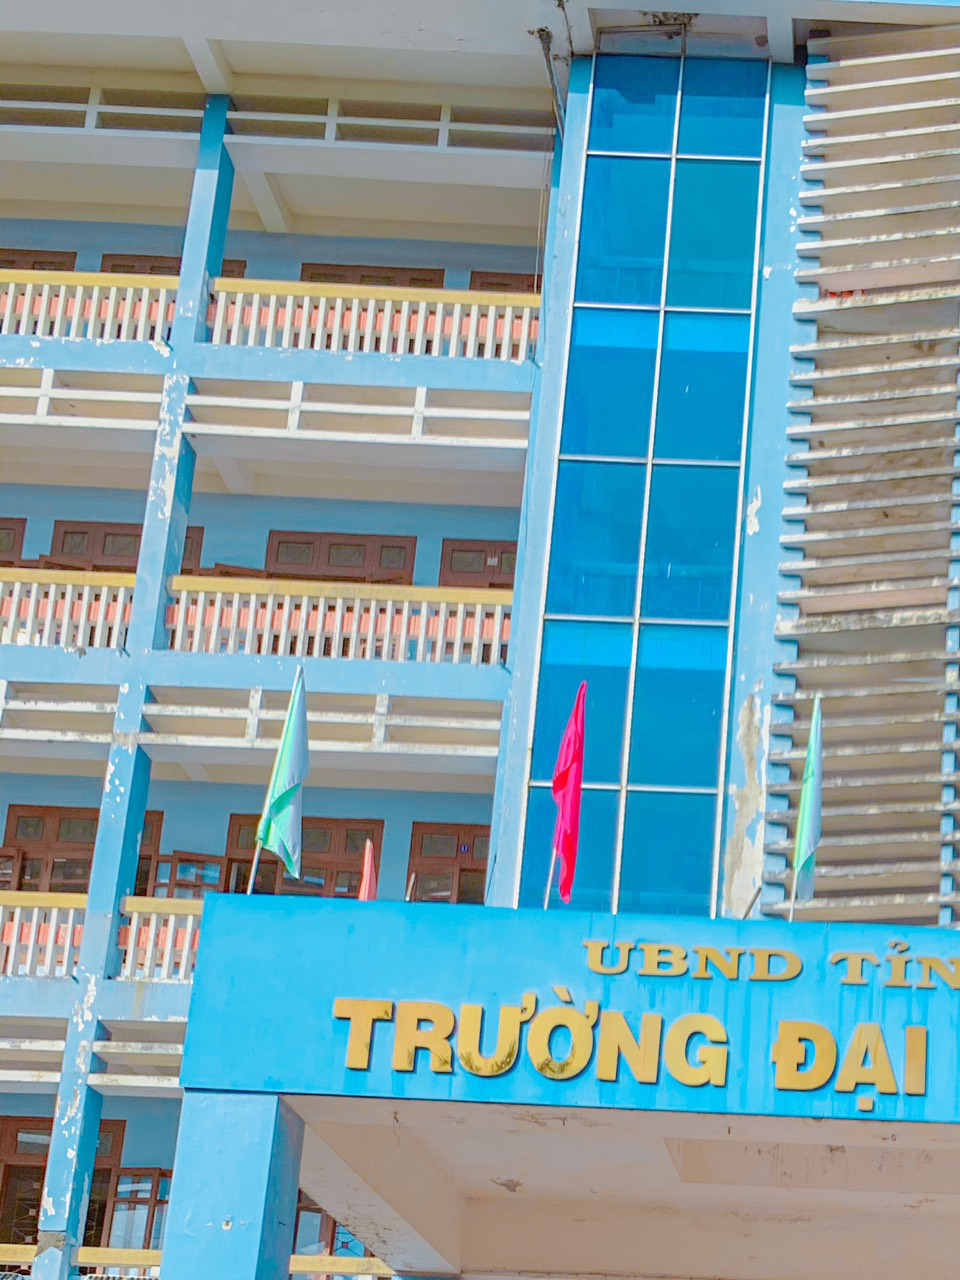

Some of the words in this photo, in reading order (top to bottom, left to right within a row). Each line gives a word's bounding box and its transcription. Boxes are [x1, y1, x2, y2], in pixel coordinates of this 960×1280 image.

[583, 940, 803, 982] UBND
[332, 985, 730, 1088] TRƯỜNG
[771, 1019, 927, 1111] ĐẠI
